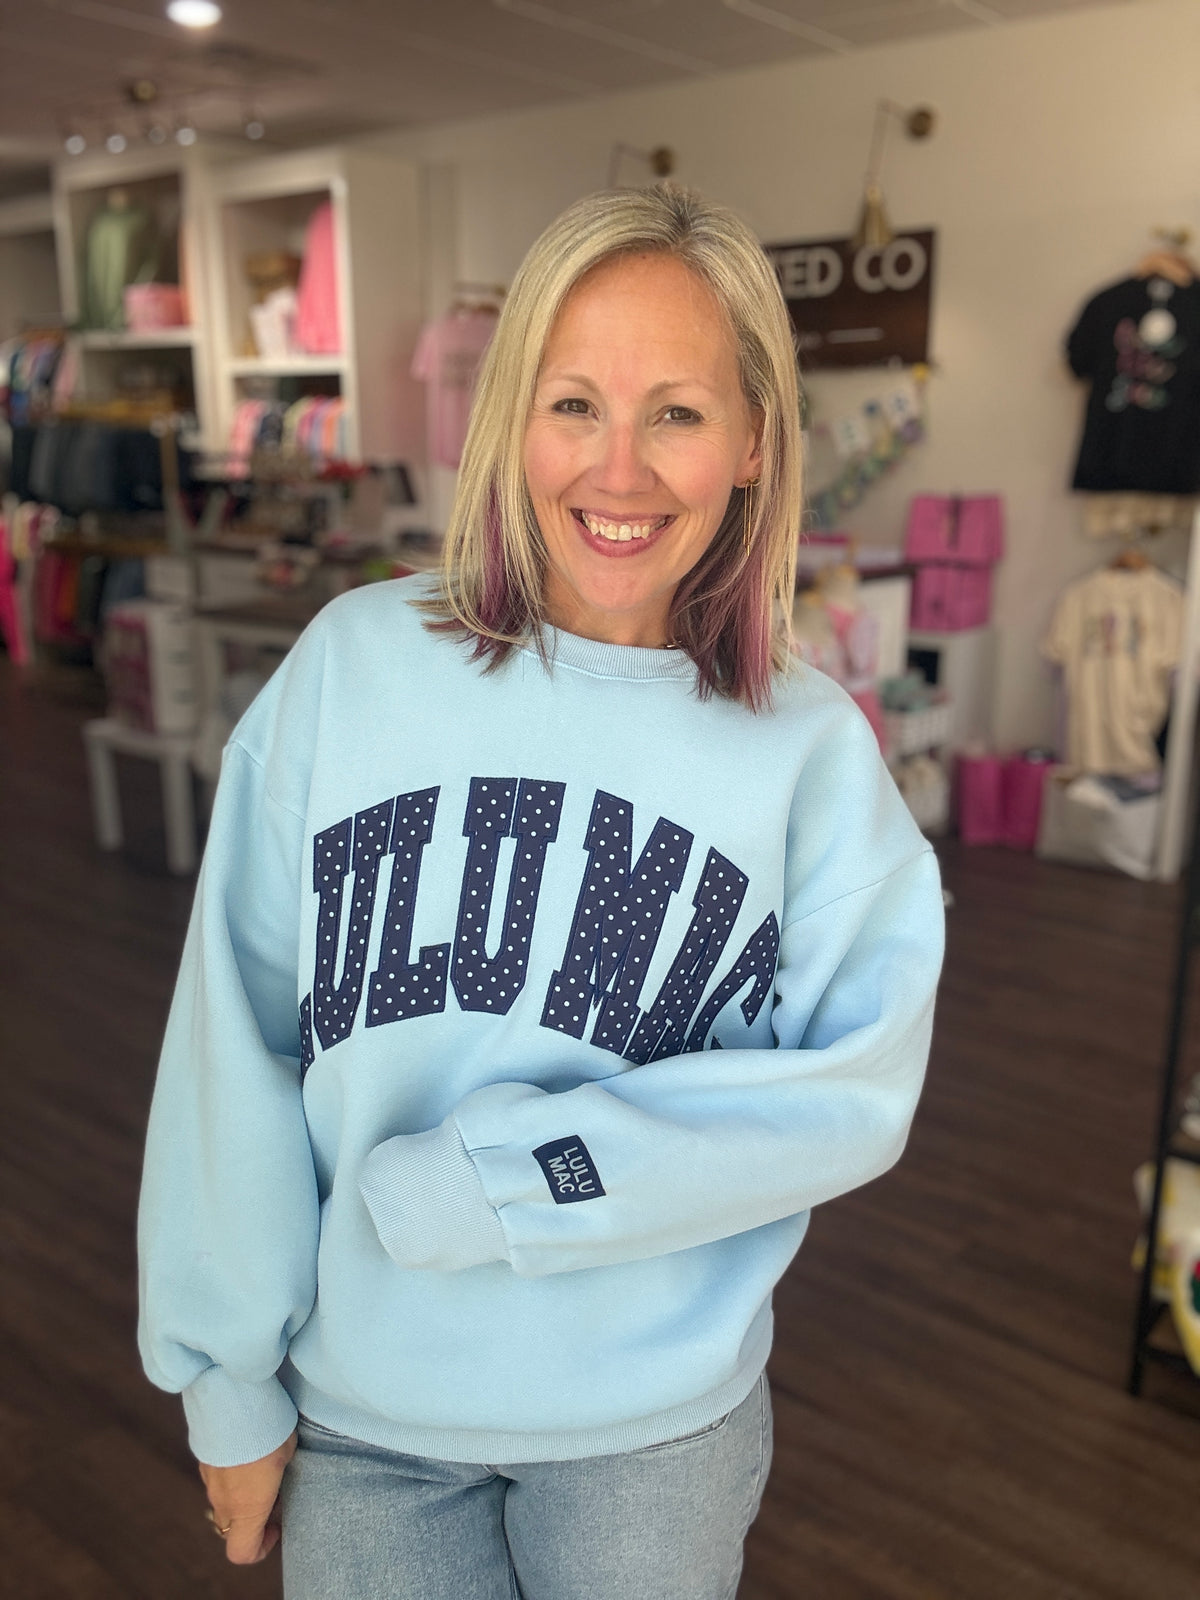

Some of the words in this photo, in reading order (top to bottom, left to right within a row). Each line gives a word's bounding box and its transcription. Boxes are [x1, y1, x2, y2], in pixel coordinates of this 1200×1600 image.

[771, 246, 843, 300] ED
[853, 237, 927, 293] CO
[299, 776, 567, 1087] ULU
[547, 1155, 575, 1194] MAC
[563, 1146, 596, 1193] LULU
